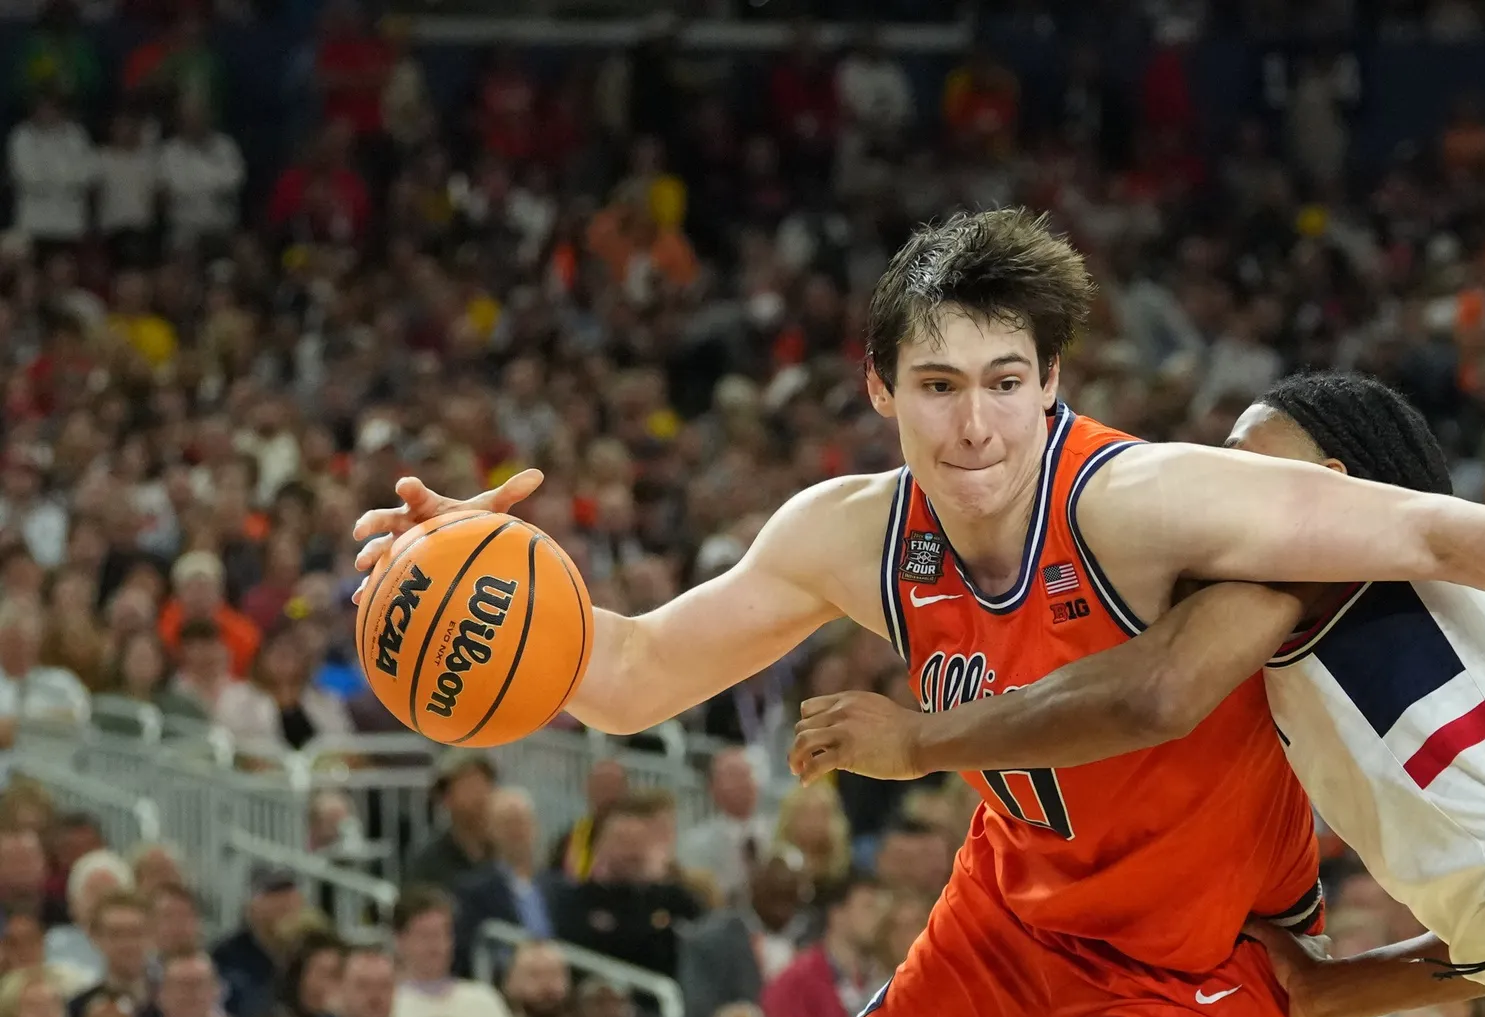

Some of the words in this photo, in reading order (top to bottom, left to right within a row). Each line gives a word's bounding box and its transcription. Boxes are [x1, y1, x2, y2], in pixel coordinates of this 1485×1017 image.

[911, 540, 940, 554] FINAL
[905, 561, 936, 575] FOUR
[375, 564, 434, 678] NCAA
[443, 620, 457, 643] EVO
[425, 574, 519, 718] Wilson
[434, 644, 447, 667] NXT
